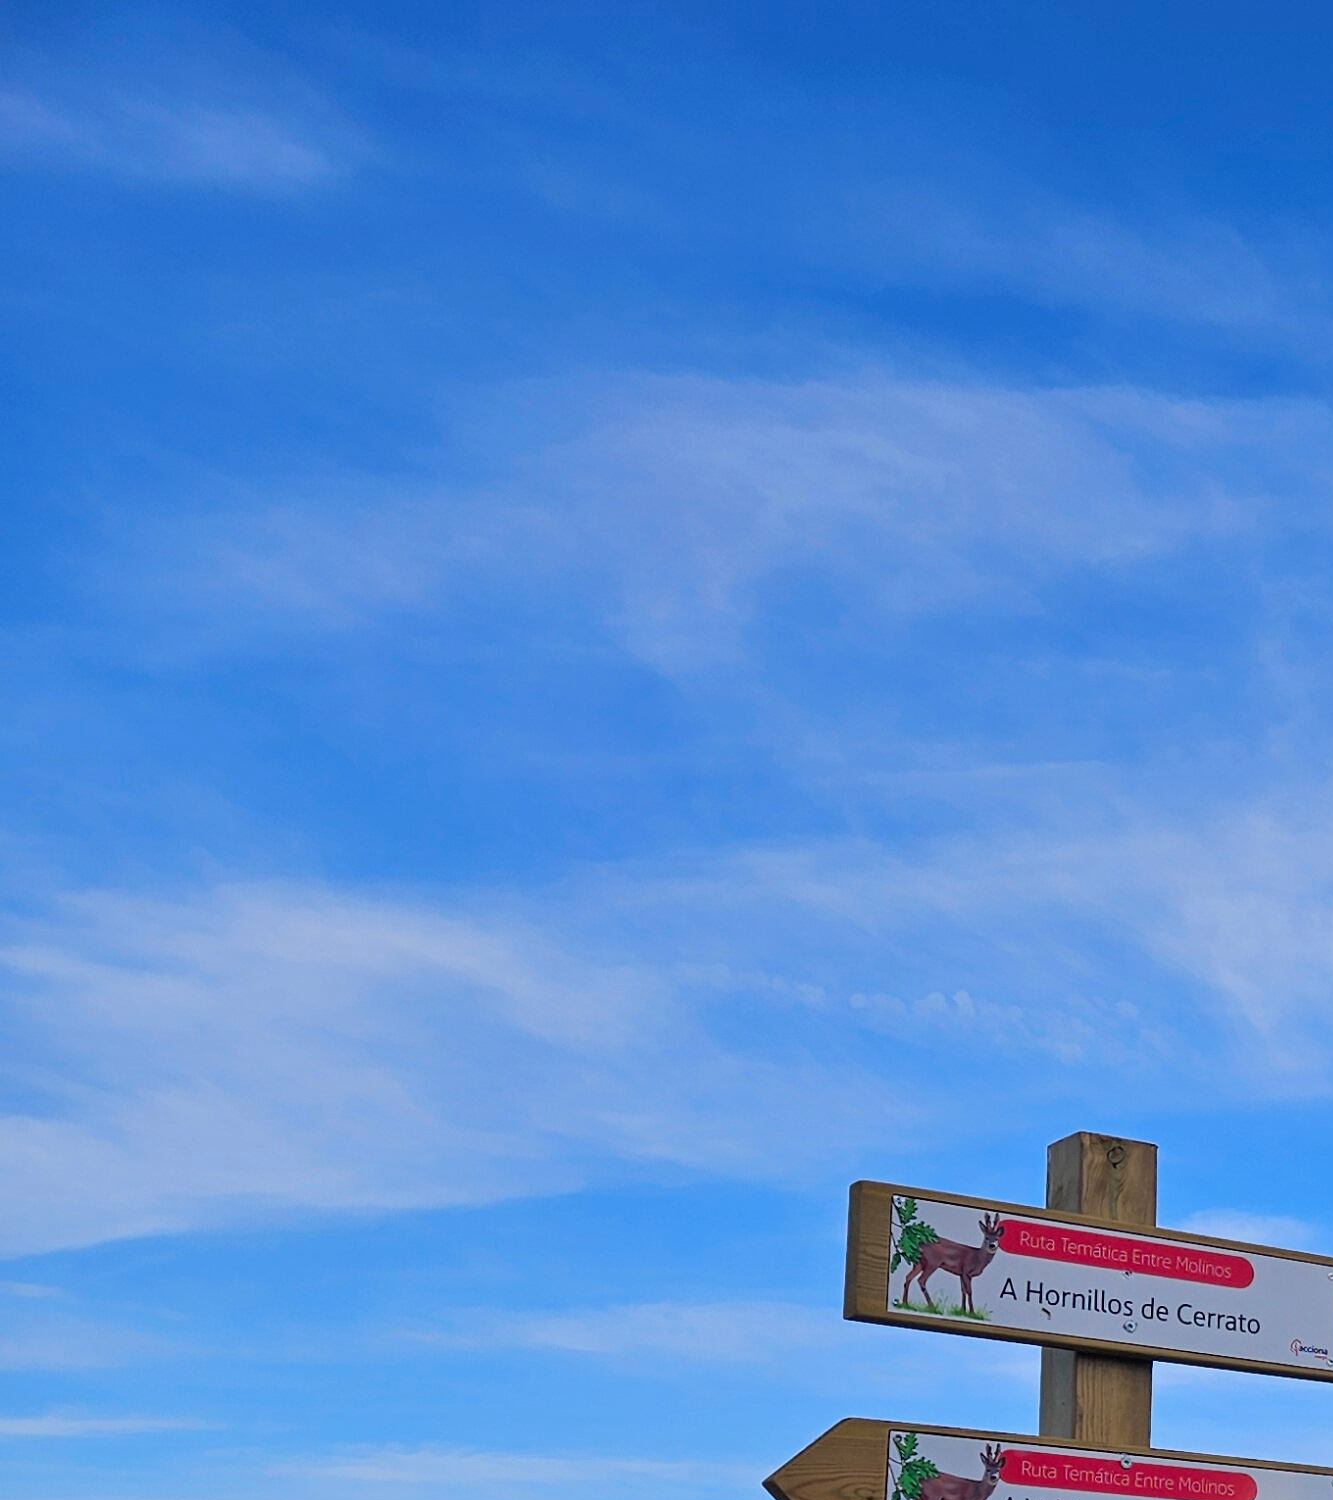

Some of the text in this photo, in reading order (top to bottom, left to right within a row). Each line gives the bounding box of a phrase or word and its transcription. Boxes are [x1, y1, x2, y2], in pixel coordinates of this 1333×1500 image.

[1019, 1230, 1232, 1279] Ruta Temática Entre Molinos
[999, 1277, 1261, 1335] A Hornillos de Cerrato
[1021, 1460, 1235, 1496] Ruta Temática Entre Molinos
